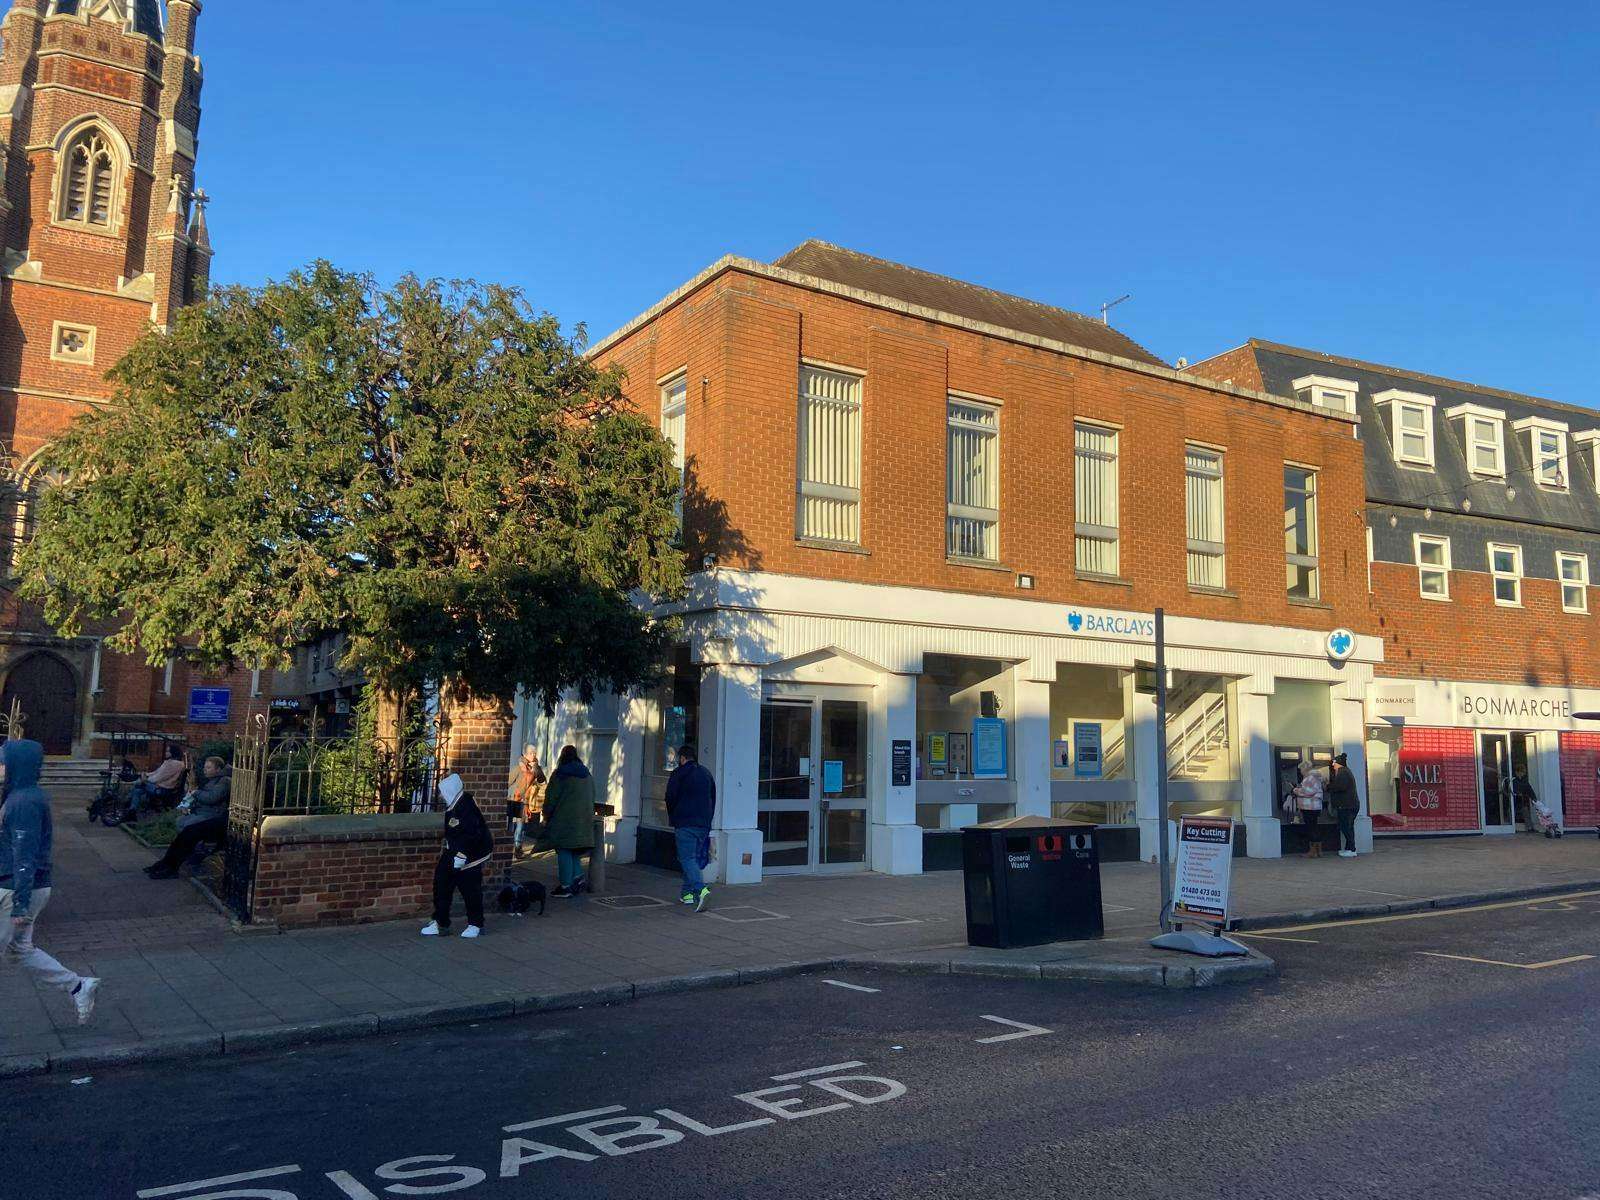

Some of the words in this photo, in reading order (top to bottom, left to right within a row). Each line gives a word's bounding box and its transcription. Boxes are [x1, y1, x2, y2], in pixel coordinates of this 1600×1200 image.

[1087, 614, 1154, 636] BARCLAYS
[1464, 696, 1569, 718] BONMARCHE
[1404, 764, 1442, 784] SALE
[1409, 789, 1439, 809] 50%
[1186, 826, 1199, 837] Key
[1200, 828, 1226, 838] Cutting
[1008, 854, 1031, 862] General
[172, 1074, 908, 1200] ISABLED
